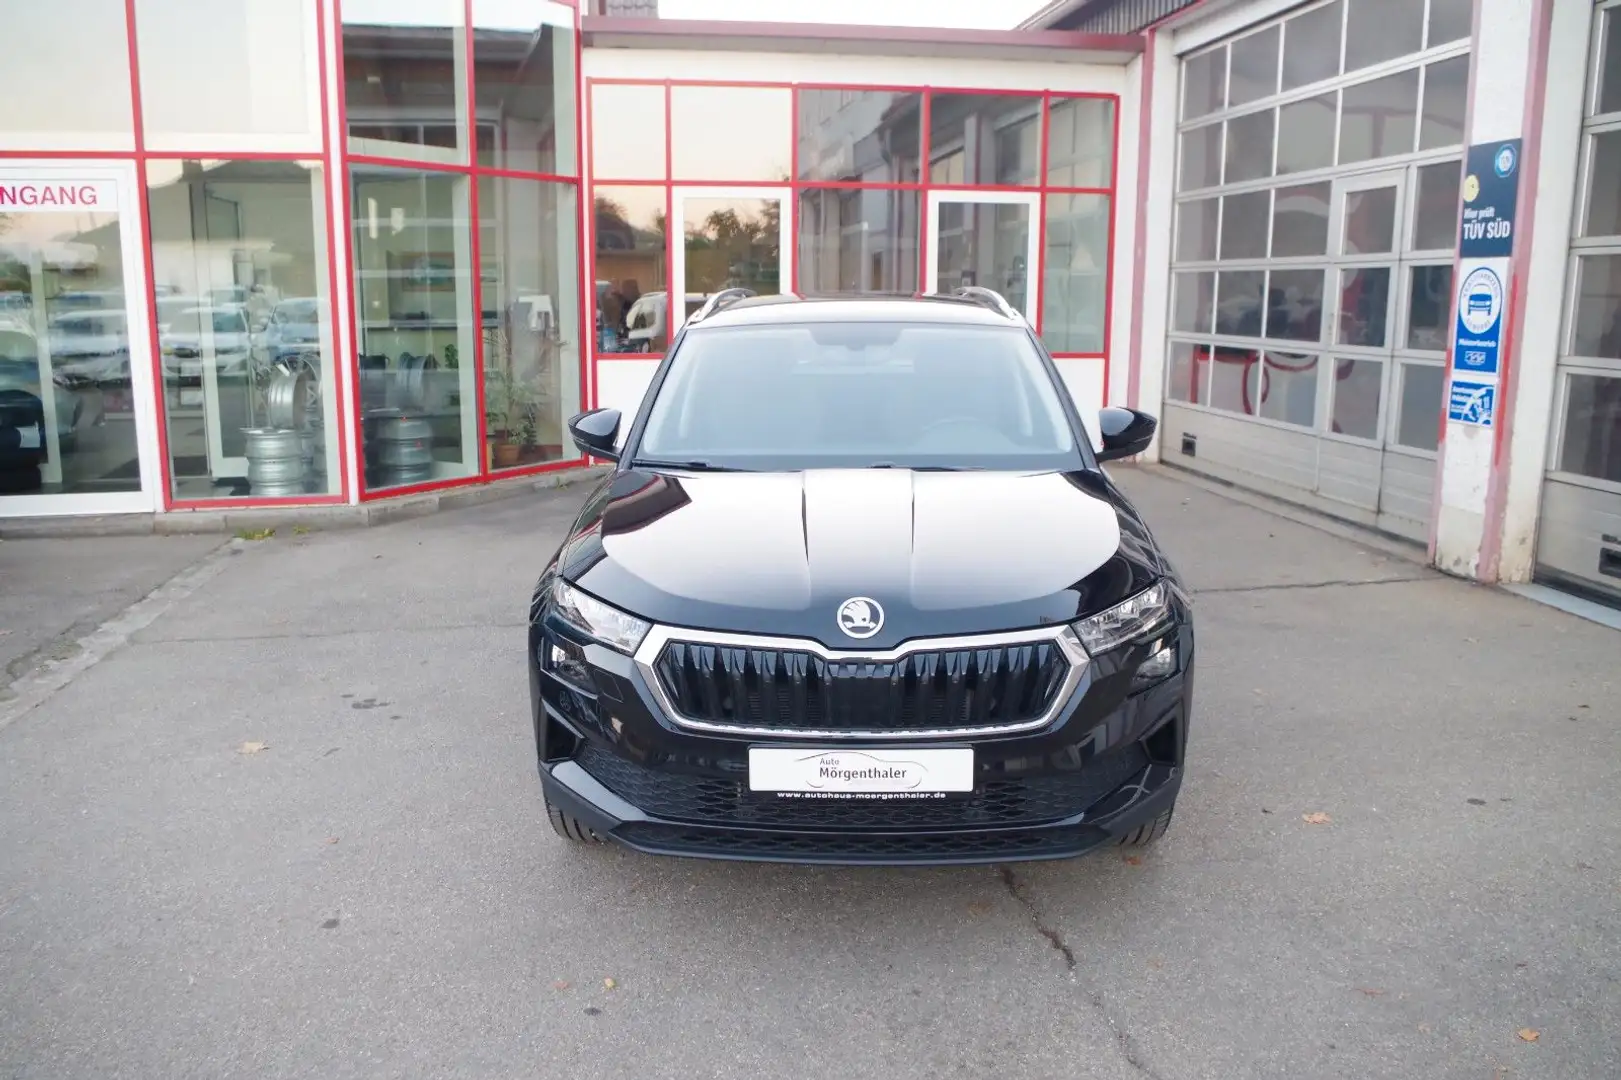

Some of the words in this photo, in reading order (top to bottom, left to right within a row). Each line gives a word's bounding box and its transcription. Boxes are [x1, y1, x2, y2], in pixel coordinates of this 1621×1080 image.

[1463, 219, 1485, 240] TÜV
[1486, 217, 1511, 239] SÜD
[819, 757, 840, 766] Auto
[819, 766, 907, 782] Mörgenthaler
[776, 791, 947, 800] www.autohaus-moergenthaler.de
